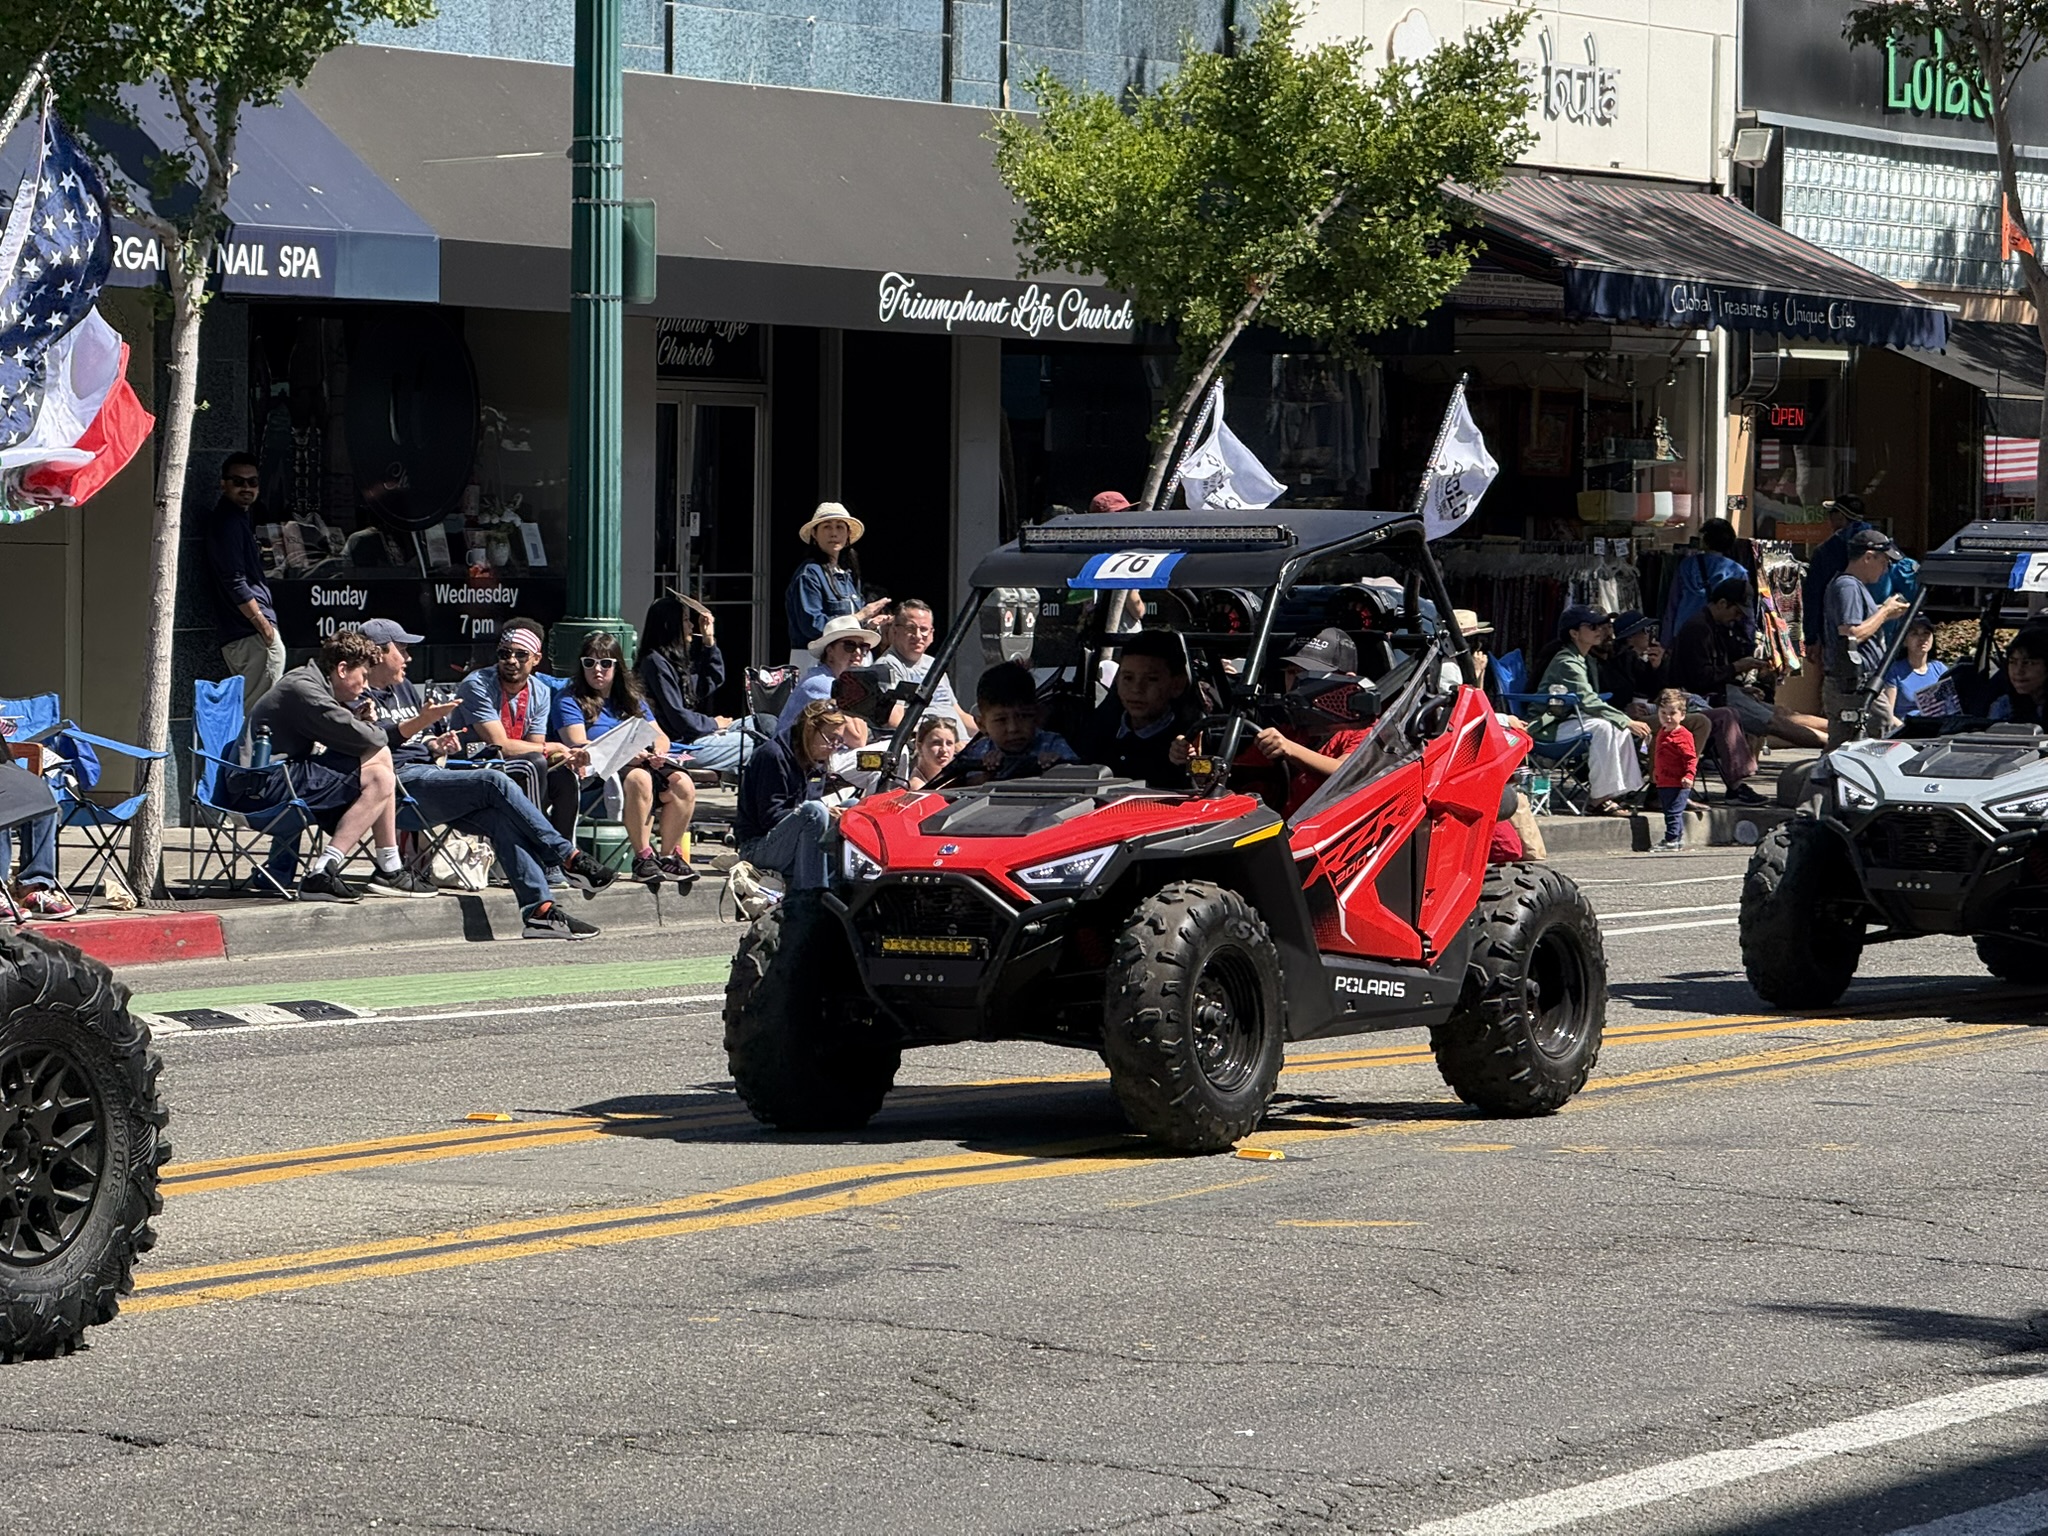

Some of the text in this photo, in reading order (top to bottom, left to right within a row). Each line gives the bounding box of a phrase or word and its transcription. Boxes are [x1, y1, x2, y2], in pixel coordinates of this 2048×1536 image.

[216, 243, 268, 276] NAIL
[278, 245, 321, 279] SPA
[879, 271, 1135, 337] Triumphant Life Church
[1671, 284, 1712, 314] Global
[1713, 289, 1768, 318] Treasures
[1772, 302, 1780, 320] &
[1785, 298, 1826, 334] Unique
[658, 336, 715, 366] Church
[1771, 408, 1804, 426] OPEN
[1109, 554, 1155, 573] 76
[310, 585, 368, 610] Sunday
[435, 583, 519, 608] Wednesday
[1042, 603, 1060, 616] am
[316, 616, 335, 637] 10
[460, 614, 494, 639] 7 pm
[1301, 796, 1408, 891] RZR
[1335, 855, 1367, 887] 200
[1334, 975, 1406, 998] POLARIS
